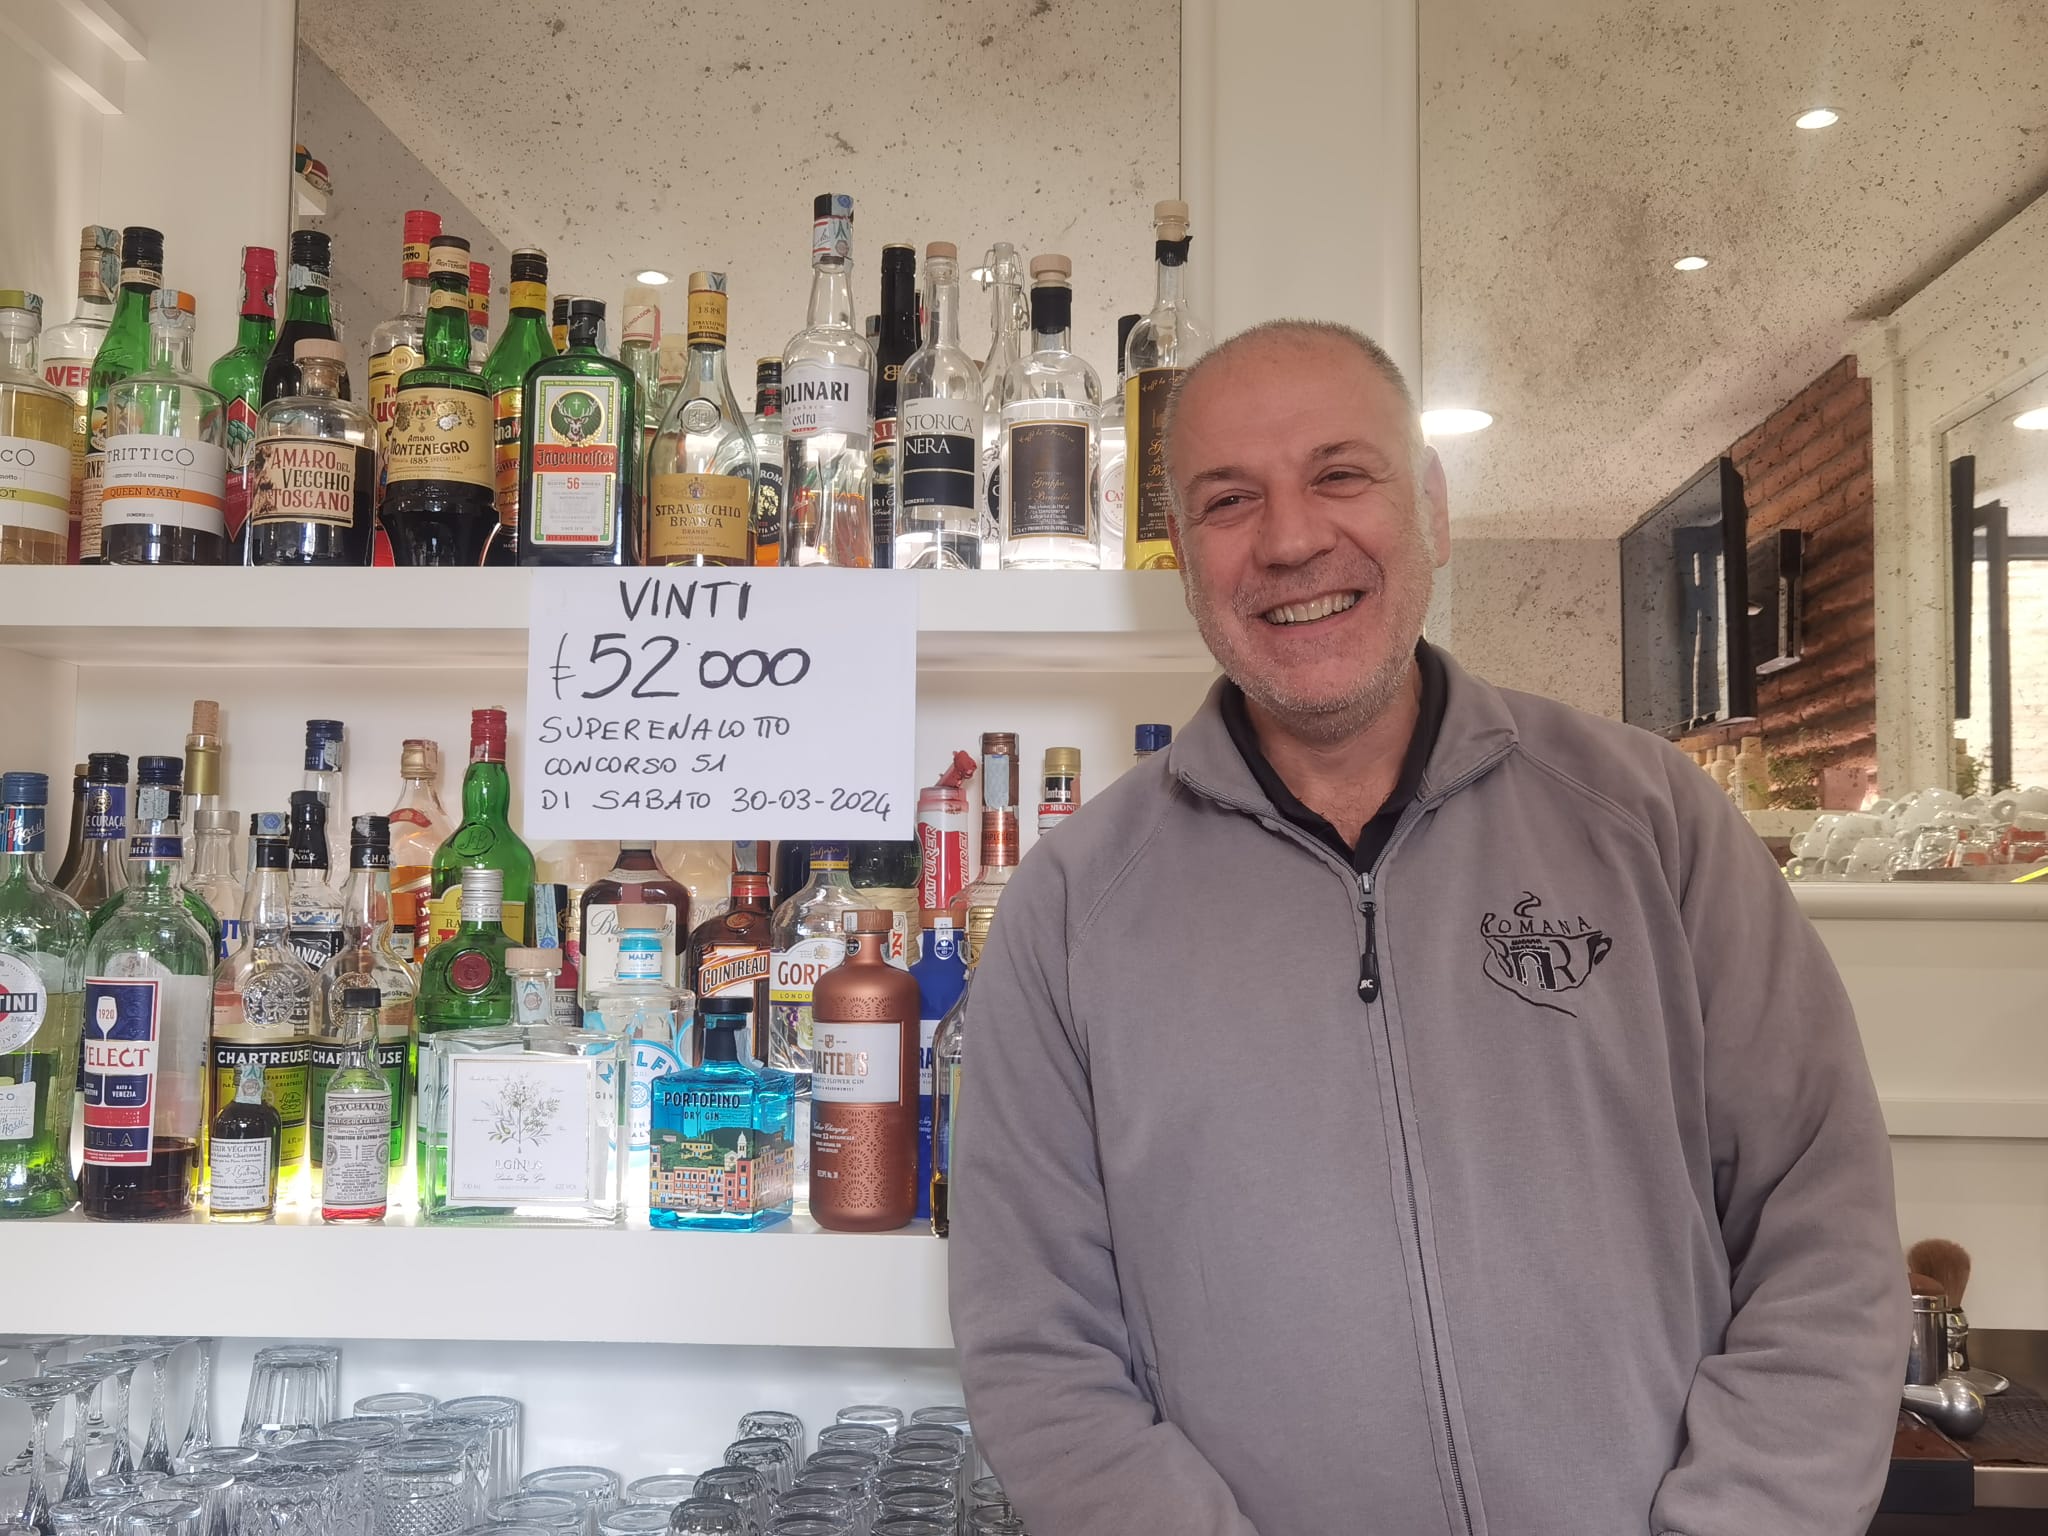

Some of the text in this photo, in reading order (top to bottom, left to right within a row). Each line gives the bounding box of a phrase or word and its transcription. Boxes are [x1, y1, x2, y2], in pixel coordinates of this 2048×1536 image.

[784, 381, 850, 406] OLINARI
[792, 412, 817, 427] extra
[905, 414, 974, 434] STORICA
[407, 434, 435, 443] AMARO
[905, 438, 951, 457] NERA
[106, 447, 195, 467] TRITTICO
[271, 447, 336, 470] AMARO
[409, 456, 429, 465] 1885
[282, 467, 350, 493] VECCHIO
[566, 477, 581, 490] 56
[110, 487, 181, 499] QUEEN MARY
[271, 488, 350, 512] TOSCANO
[619, 577, 752, 622] VINTI
[544, 754, 727, 776] CONCORSO 51
[541, 786, 892, 822] DI SABATO 30-03-2024
[1481, 913, 1592, 937] ROMANA
[701, 955, 767, 994] COINTREAU
[779, 991, 811, 999] LONDO
[98, 1008, 115, 1021] 1920
[84, 1046, 152, 1069] ELECT
[217, 1050, 311, 1065] CHARTREUSE
[112, 1090, 137, 1098] VENEZIA
[663, 1090, 742, 1109] PORTOFINO
[684, 1111, 720, 1120] DRY GIN
